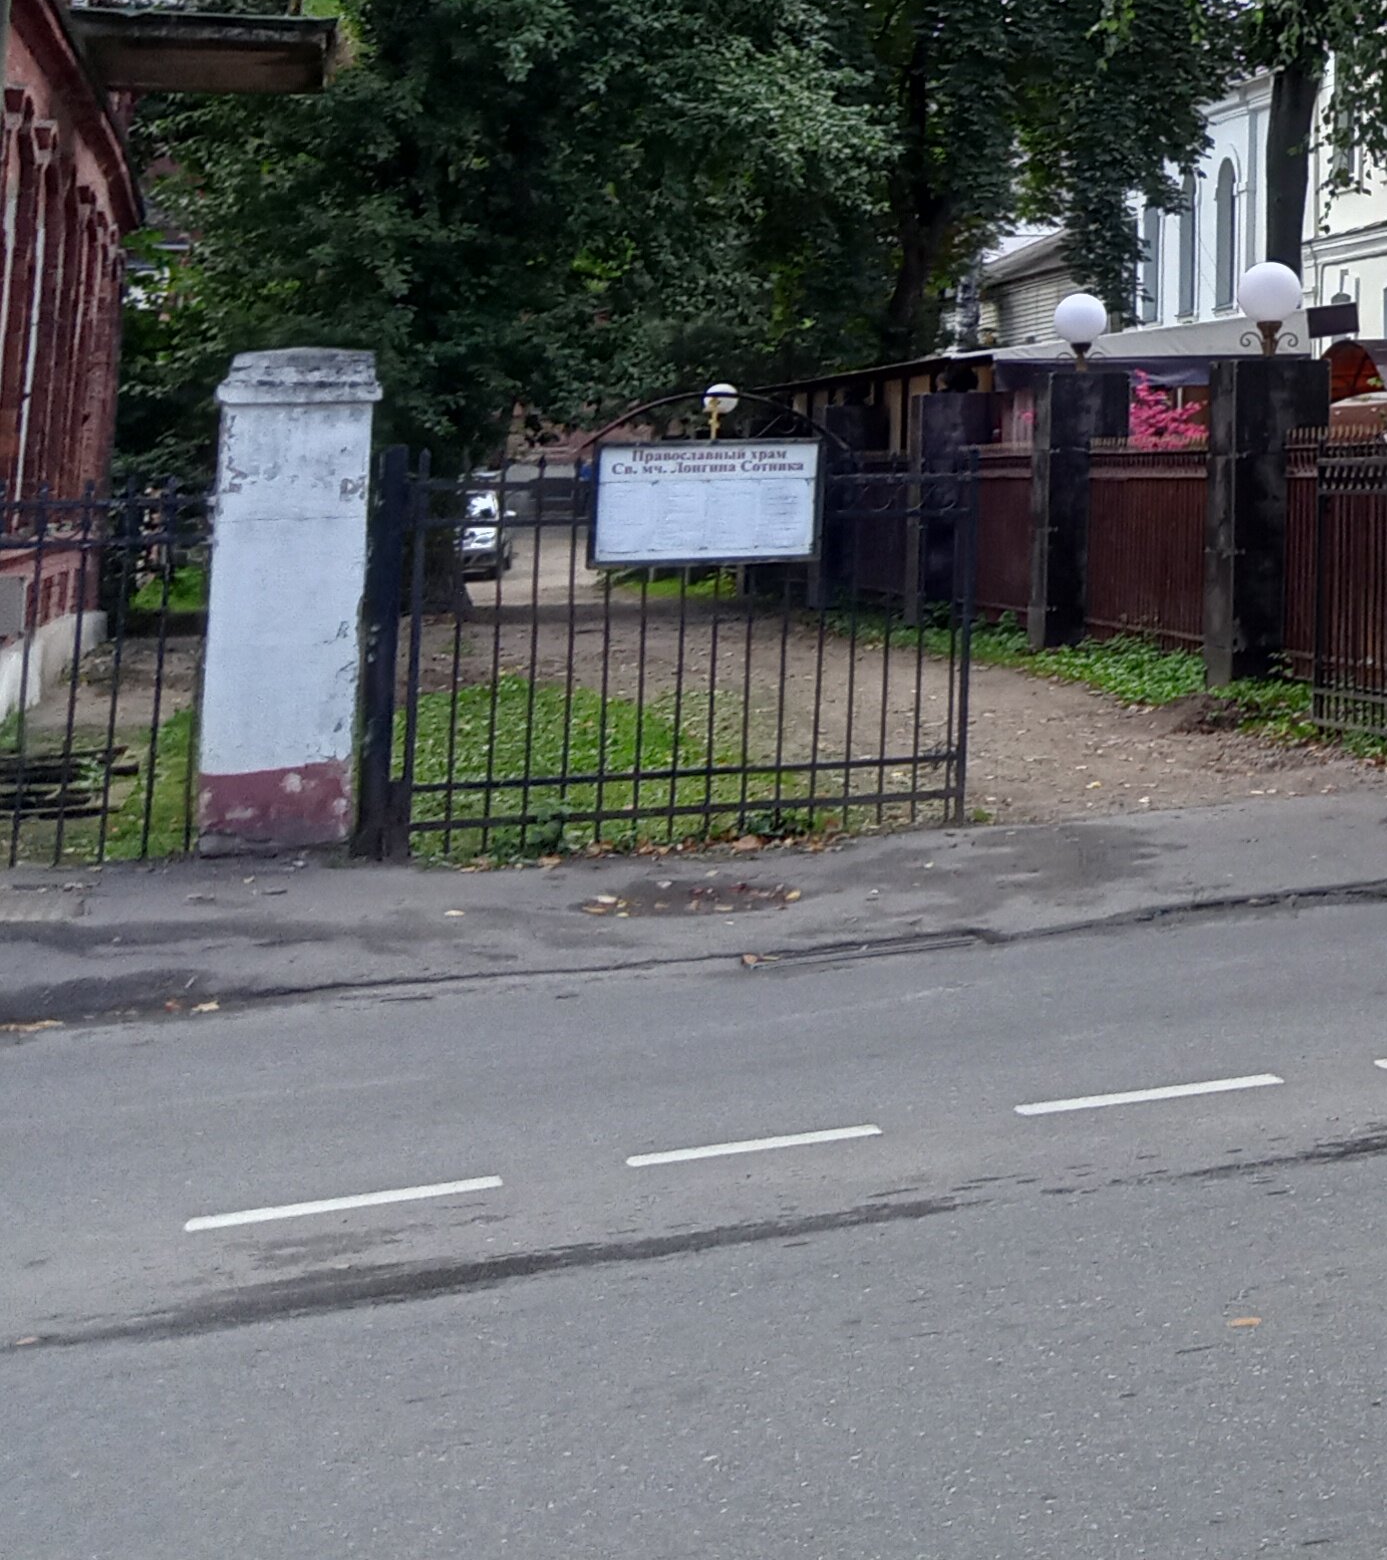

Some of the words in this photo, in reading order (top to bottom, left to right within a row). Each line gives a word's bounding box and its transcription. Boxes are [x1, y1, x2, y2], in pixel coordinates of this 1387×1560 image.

[632, 448, 745, 463] Православный
[751, 449, 787, 463] храм
[611, 462, 637, 475] Св.
[642, 465, 667, 475] мч.
[670, 461, 736, 474] Лонгина
[740, 460, 804, 473] Сотника
